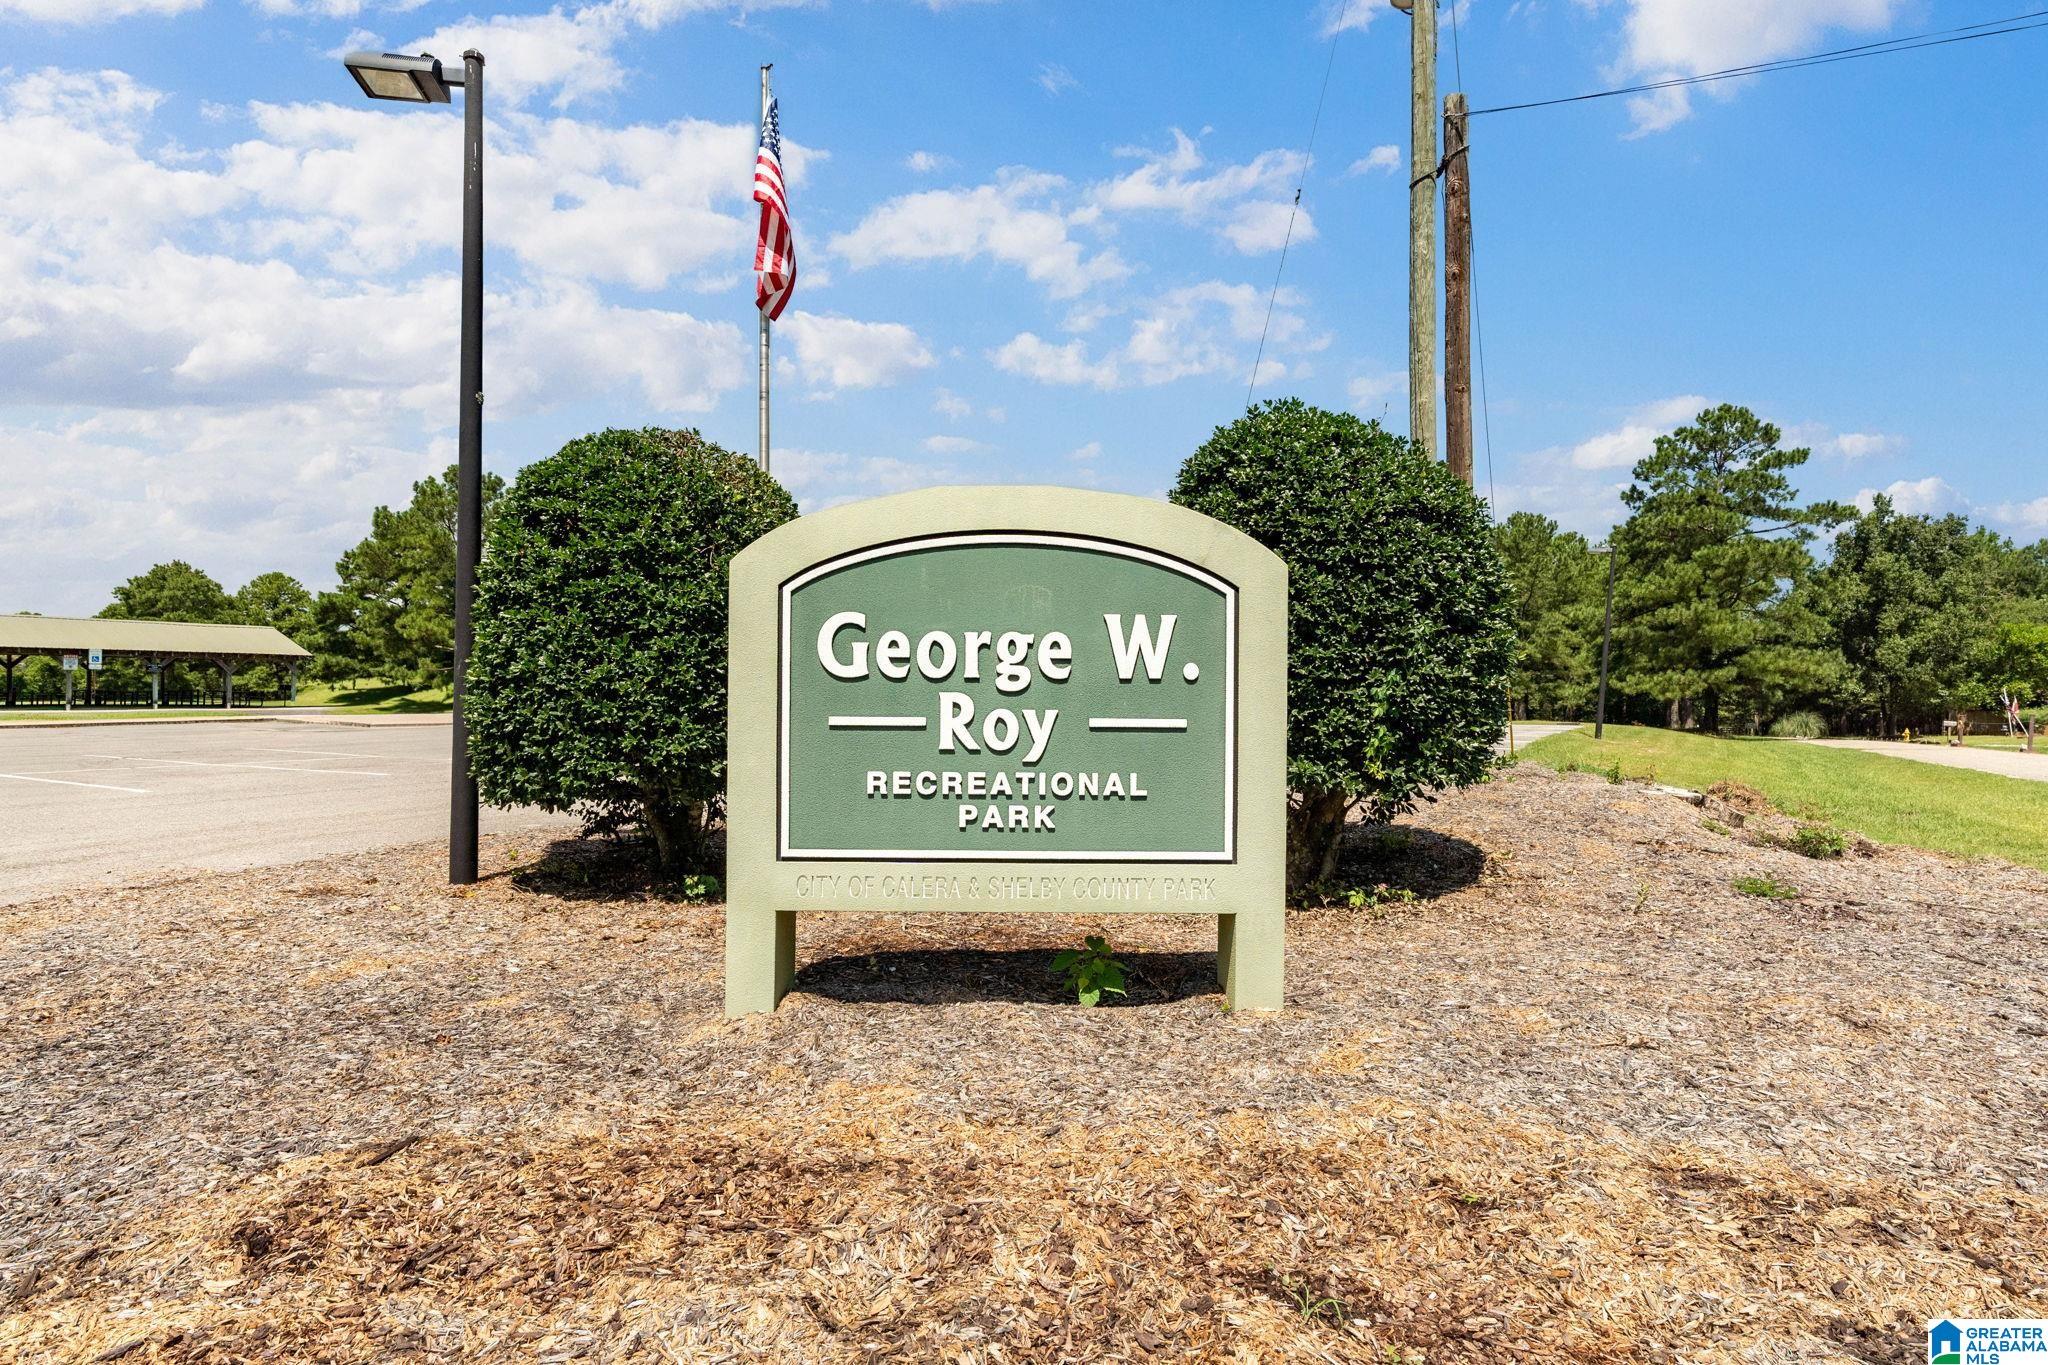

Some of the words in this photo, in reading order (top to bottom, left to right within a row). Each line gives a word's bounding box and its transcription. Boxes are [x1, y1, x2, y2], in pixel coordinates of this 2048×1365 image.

[817, 611, 1073, 692] George
[1103, 613, 1200, 681] W.
[938, 691, 1059, 763] Roy
[866, 771, 1148, 797] RECREATIONAL
[958, 805, 1056, 829] PARK
[796, 875, 841, 898] CITY
[849, 875, 875, 898] OF
[882, 875, 961, 899] CALERA
[968, 876, 980, 899] &
[988, 876, 1066, 900] SHELBY
[1073, 876, 1156, 900] COUNTY
[1164, 877, 1217, 900] PARK
